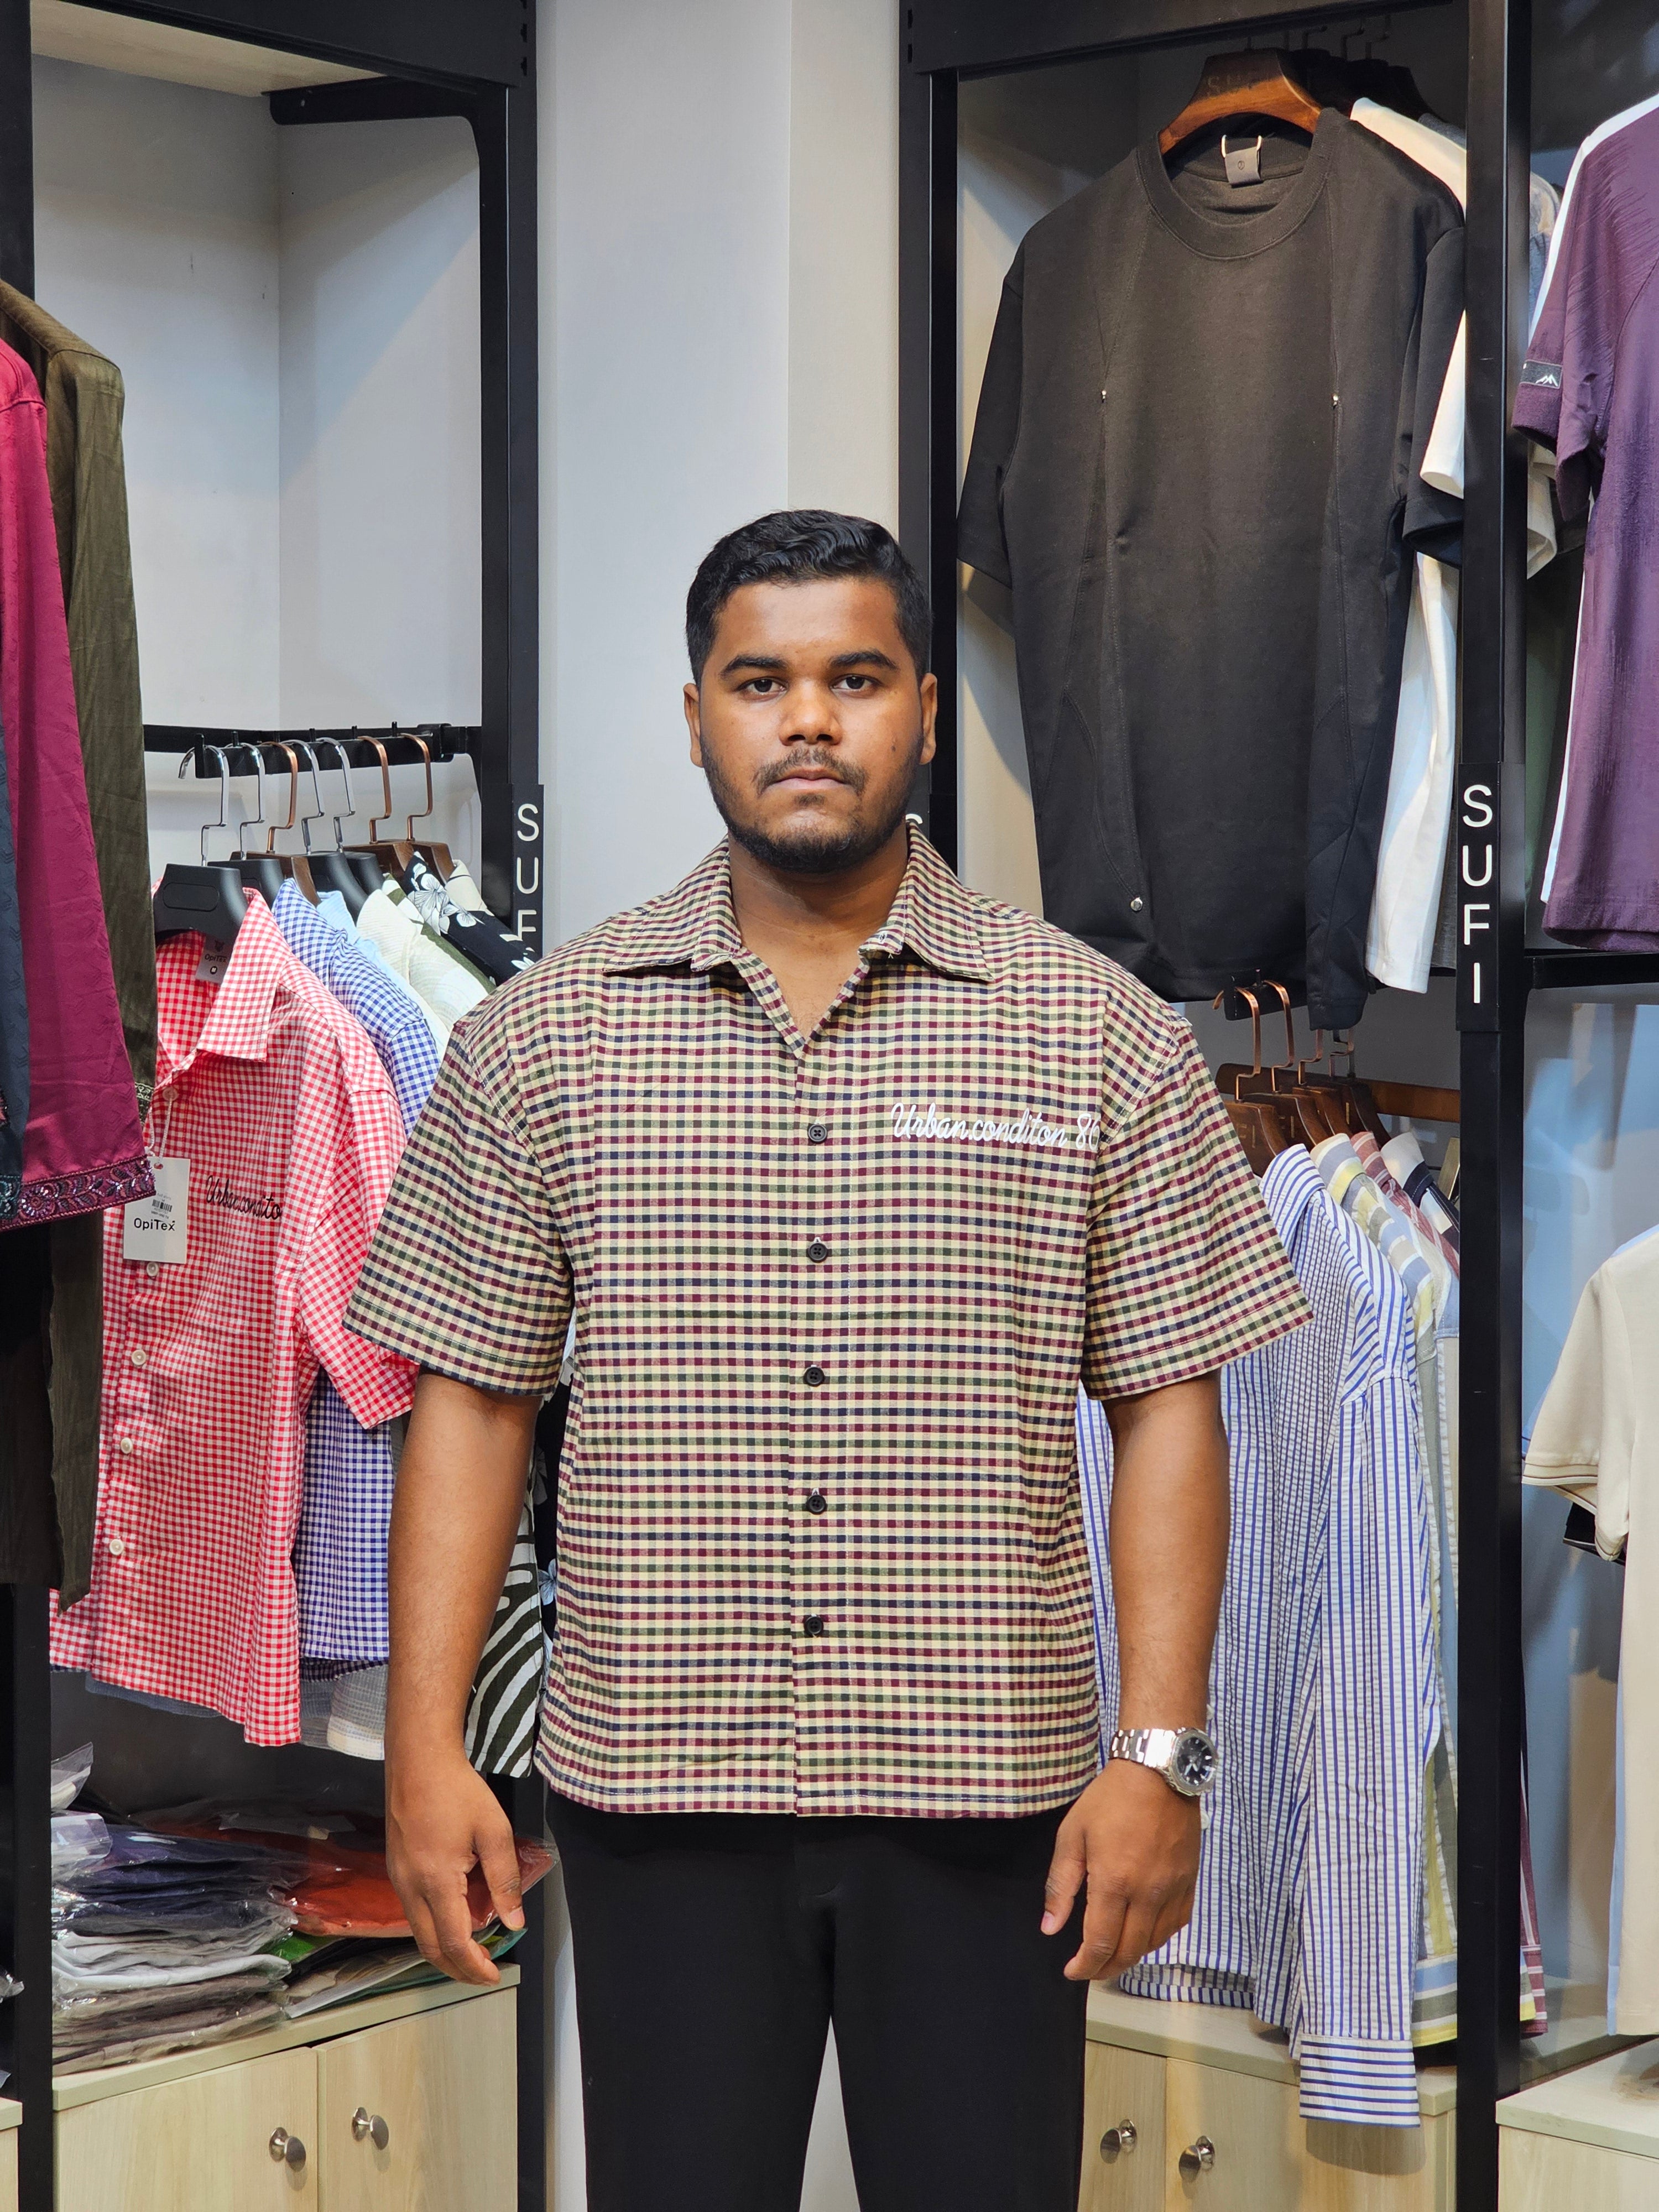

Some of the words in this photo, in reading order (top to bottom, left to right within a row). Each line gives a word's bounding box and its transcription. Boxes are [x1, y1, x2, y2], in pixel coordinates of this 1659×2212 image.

[516, 804, 540, 941] SUF
[1462, 784, 1493, 1004] SUFI
[204, 953, 227, 963] OpiTex
[890, 1102, 1068, 1147] Urban.conditon
[134, 1217, 175, 1232] OpiTex
